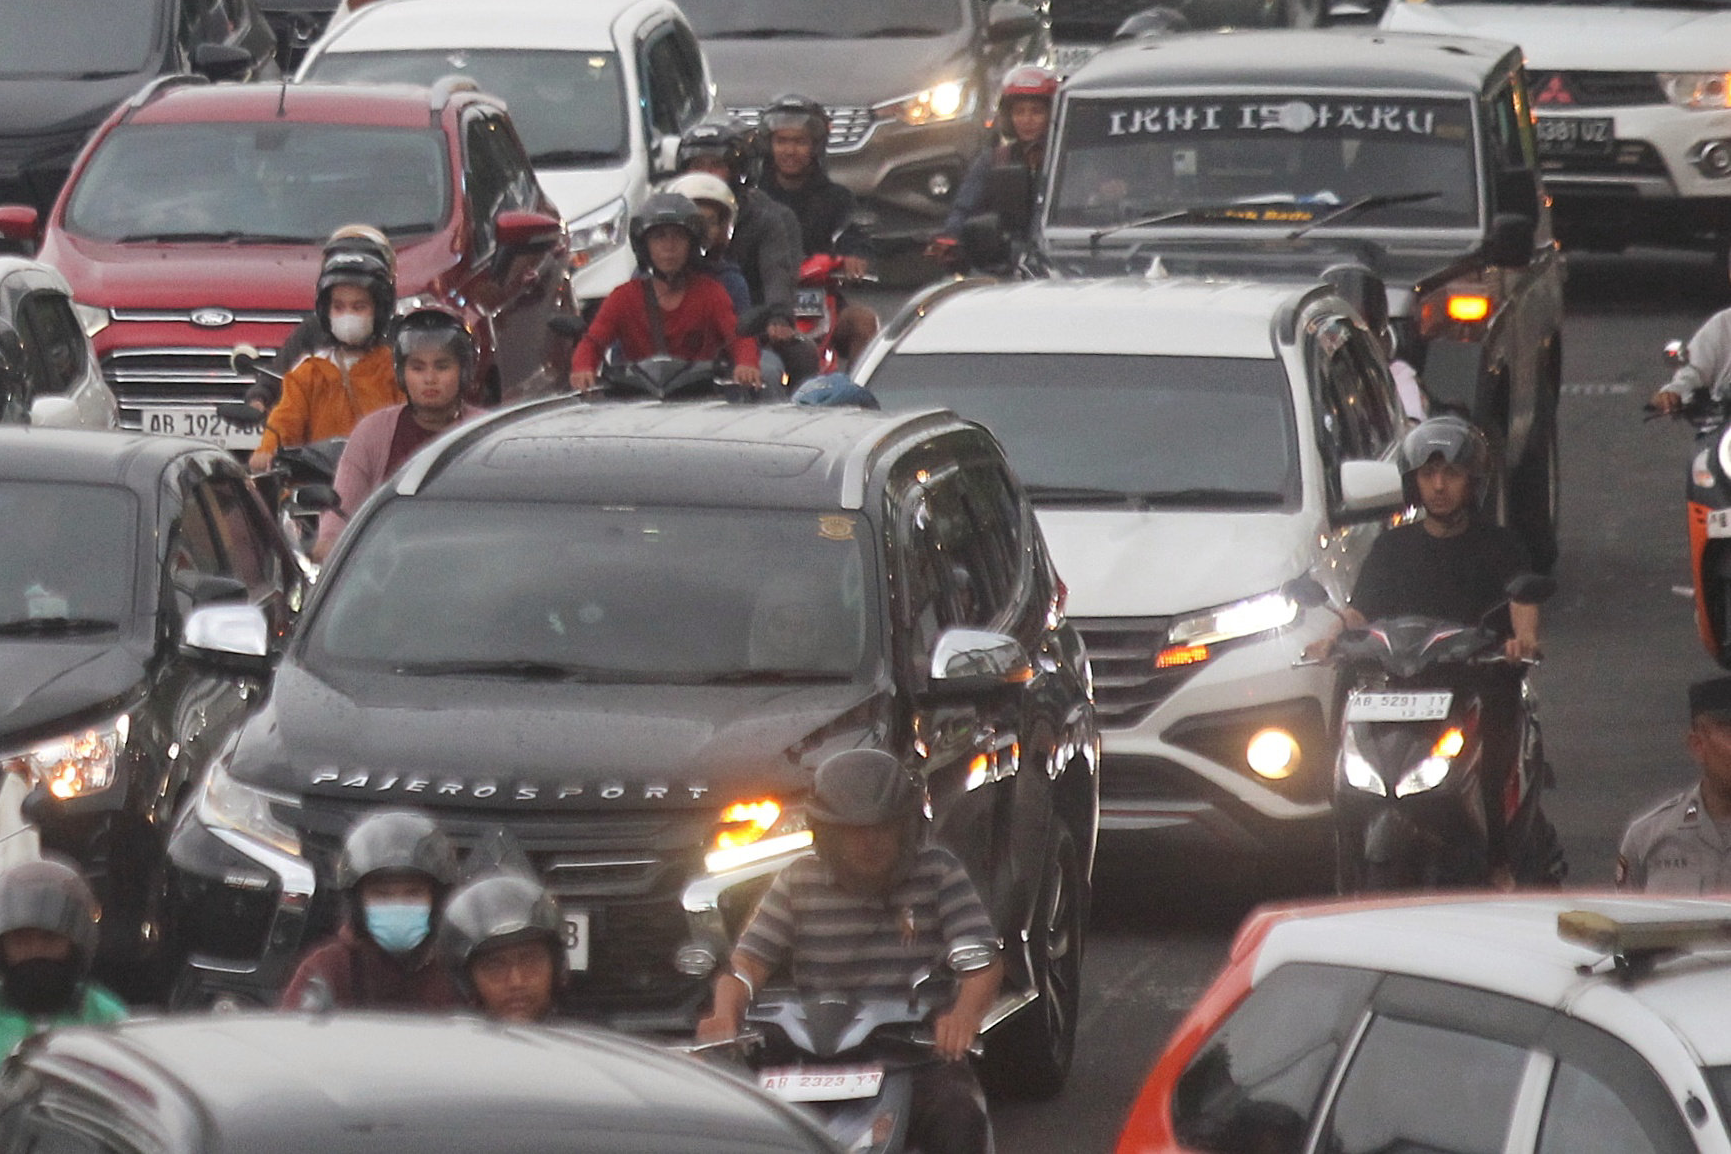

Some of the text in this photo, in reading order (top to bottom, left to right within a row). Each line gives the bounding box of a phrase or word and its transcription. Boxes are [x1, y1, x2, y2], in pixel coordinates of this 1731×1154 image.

[150, 413, 175, 434] AB
[1353, 696, 1373, 707] AB
[1381, 696, 1418, 707] 5291
[312, 773, 710, 801] PAJERO SPORT
[765, 1077, 788, 1089] AB
[799, 1076, 845, 1087] 2323
